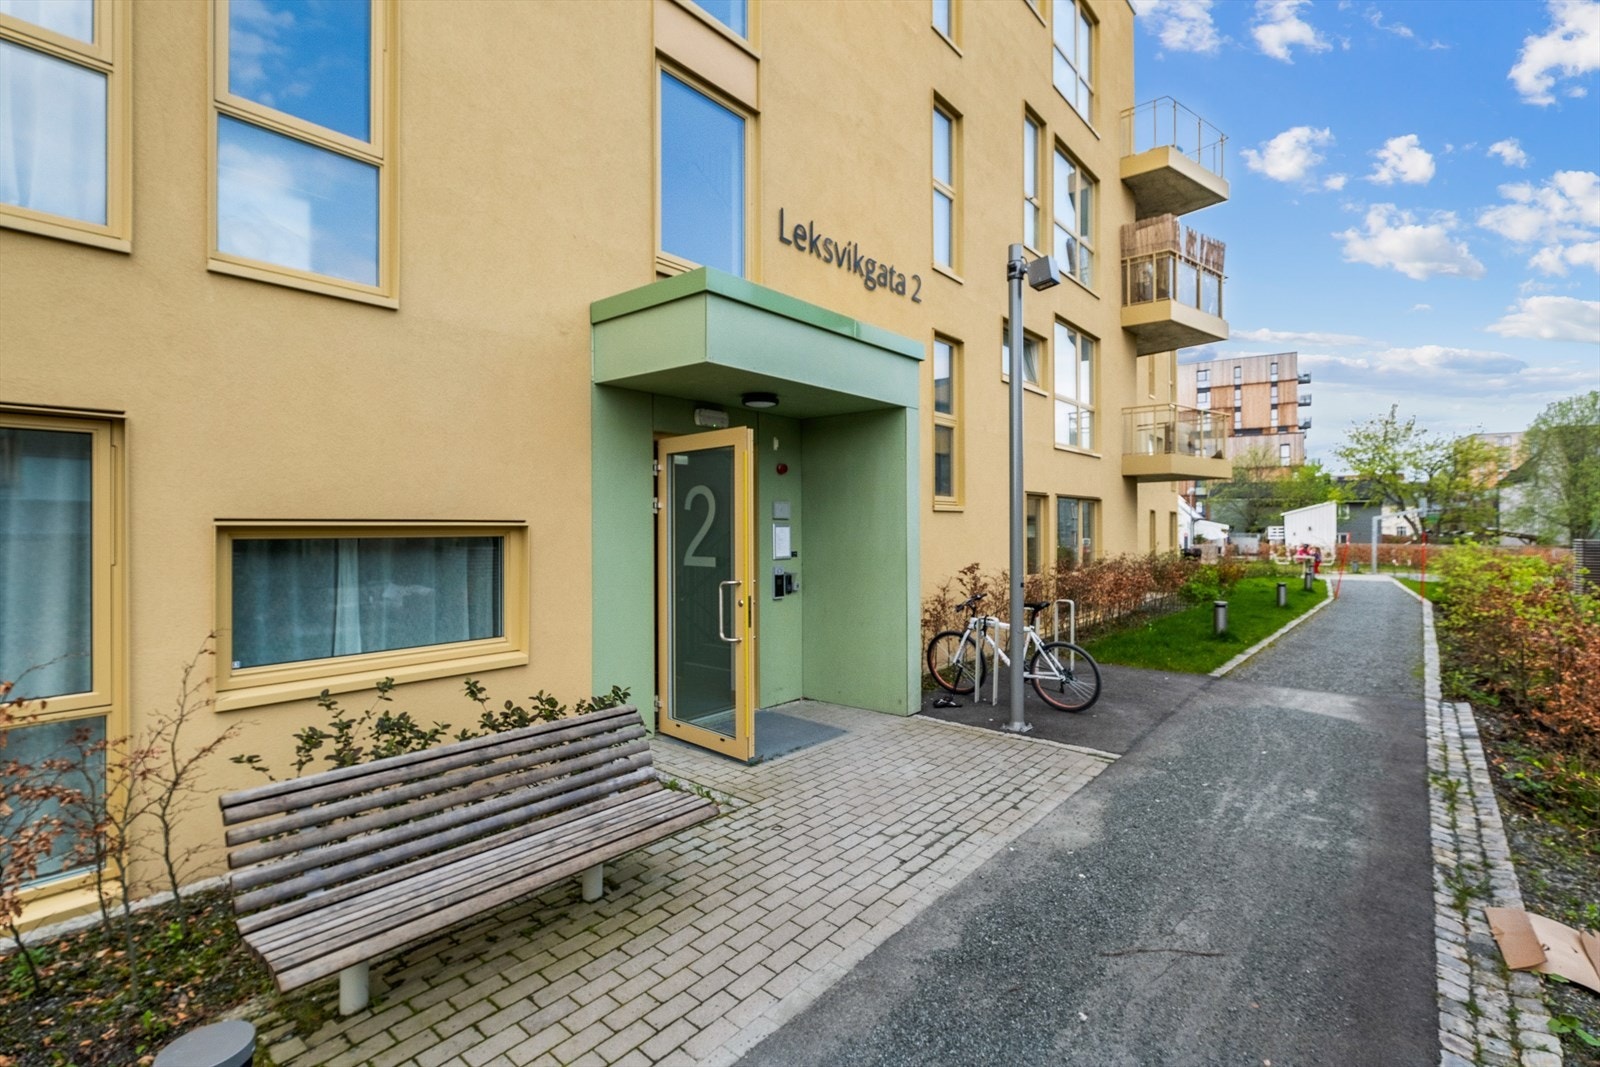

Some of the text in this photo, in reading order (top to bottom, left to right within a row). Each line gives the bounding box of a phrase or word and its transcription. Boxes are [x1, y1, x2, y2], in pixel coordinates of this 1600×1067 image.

[779, 207, 922, 303] Leksvikgata 2
[684, 485, 716, 567] 2
